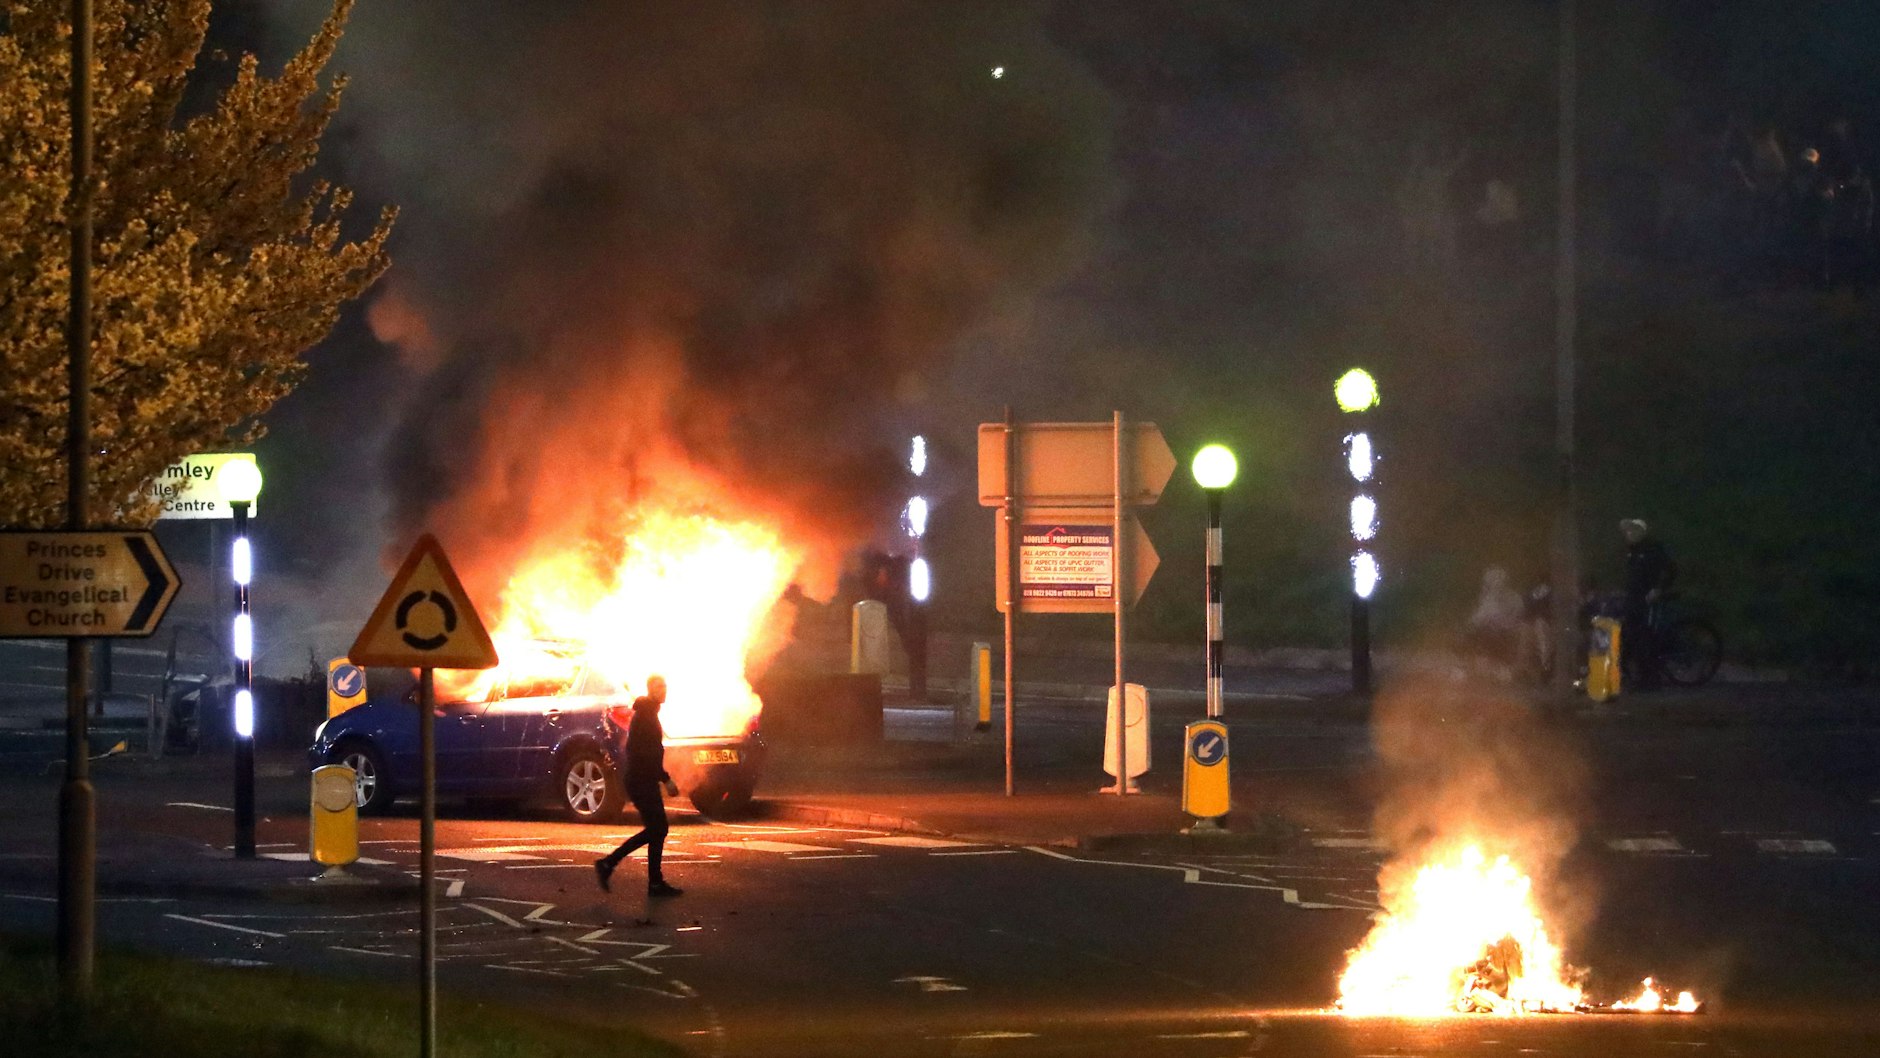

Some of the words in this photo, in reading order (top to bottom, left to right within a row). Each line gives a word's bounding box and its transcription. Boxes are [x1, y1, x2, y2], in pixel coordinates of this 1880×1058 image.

[165, 500, 215, 511] Centre
[1052, 536, 1081, 544] PROPERTY
[1082, 536, 1109, 544] SERVICES
[27, 541, 107, 557] Princes
[38, 564, 95, 580] Drive
[4, 586, 129, 606] Evangelical
[27, 609, 106, 626] Church
